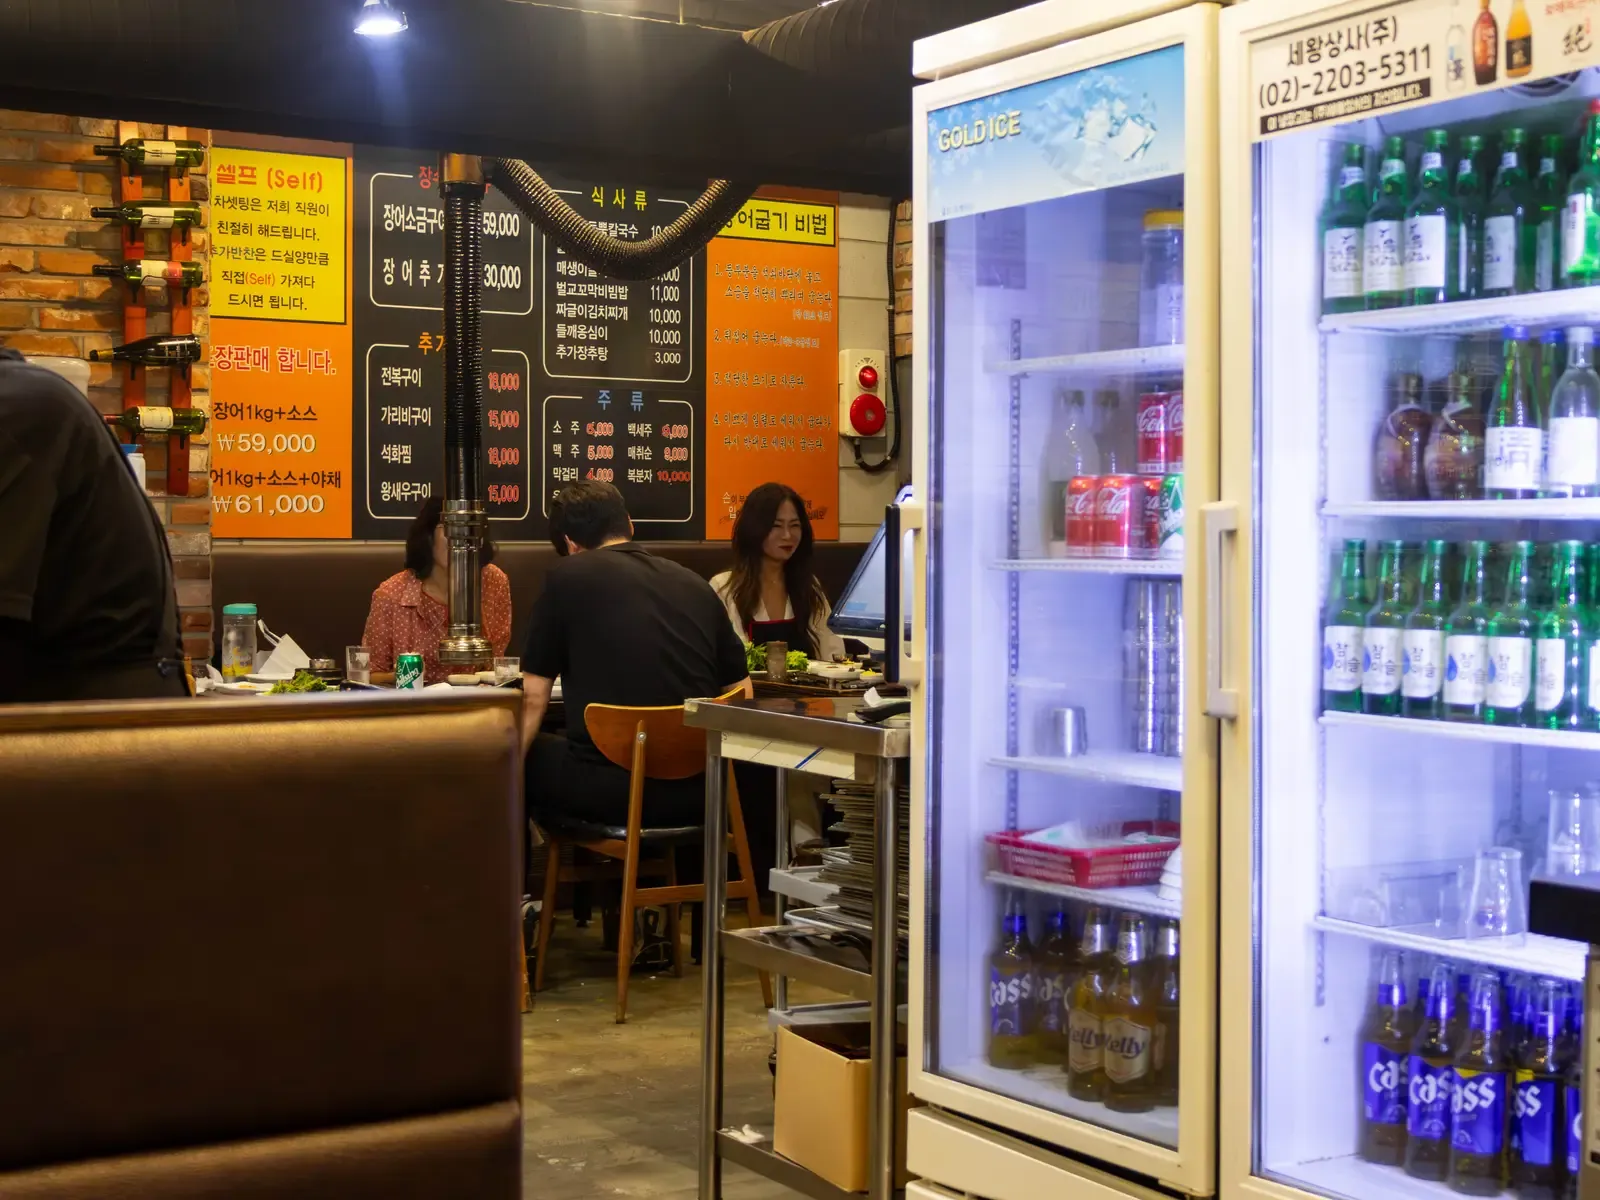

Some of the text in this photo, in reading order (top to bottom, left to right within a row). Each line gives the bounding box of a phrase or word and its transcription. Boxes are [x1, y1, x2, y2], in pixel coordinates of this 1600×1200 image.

[1286, 16, 1397, 67] 세왕상사(주)
[1259, 43, 1432, 108] (02)-2203-5311
[938, 110, 1022, 152] GOLD ICE
[216, 163, 323, 193] 셀프 (Self)
[267, 199, 290, 214] 저희
[296, 201, 330, 217] 직원이
[217, 220, 320, 241] 친절히 해드립니다.
[482, 211, 520, 239] 59,000
[795, 213, 827, 236] 비법
[271, 249, 330, 266] 드실양만큼
[221, 270, 316, 289] 직접(Self) 가져다
[483, 263, 521, 291] 30,000
[228, 293, 308, 311] 드시면 됩니다.
[556, 281, 680, 303] 벌교꼬막비빔밥 11,000
[556, 302, 681, 324] 짜글이김치찌개 10,000
[556, 323, 681, 347] 들깨옹심이 10,000
[277, 346, 337, 375] 합니다.
[556, 344, 681, 365] 추가장추탕 3,000
[381, 366, 520, 393] 전복구이 18,000
[213, 402, 318, 422] 장어1kg+소스
[381, 405, 520, 431] 가리비구이 15,000
[627, 423, 652, 438] 백세주
[381, 443, 412, 464] 석화찜
[587, 445, 614, 461] 5,000
[627, 446, 652, 461] 매취순
[552, 467, 579, 482] 막걸리
[627, 469, 653, 484] 복분자
[381, 480, 520, 505] 왕새우구이 15,000
